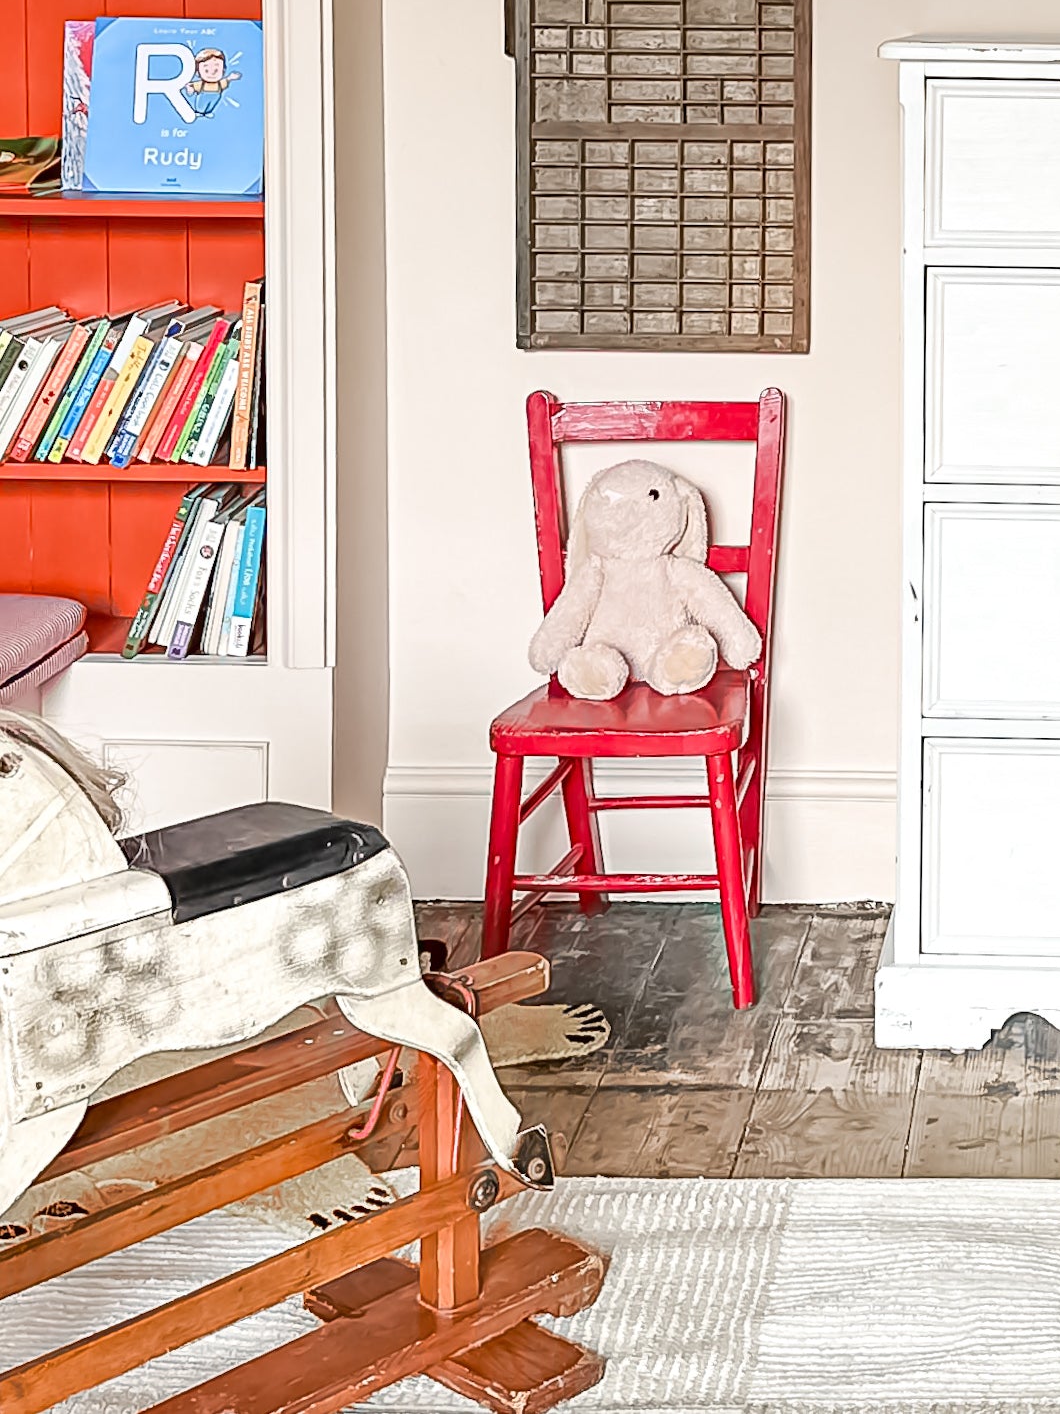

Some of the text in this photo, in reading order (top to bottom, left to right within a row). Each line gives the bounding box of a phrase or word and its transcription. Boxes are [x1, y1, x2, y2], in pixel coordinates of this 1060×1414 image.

[133, 42, 197, 125] R
[160, 127, 189, 138] is for
[143, 147, 203, 170] Rudy
